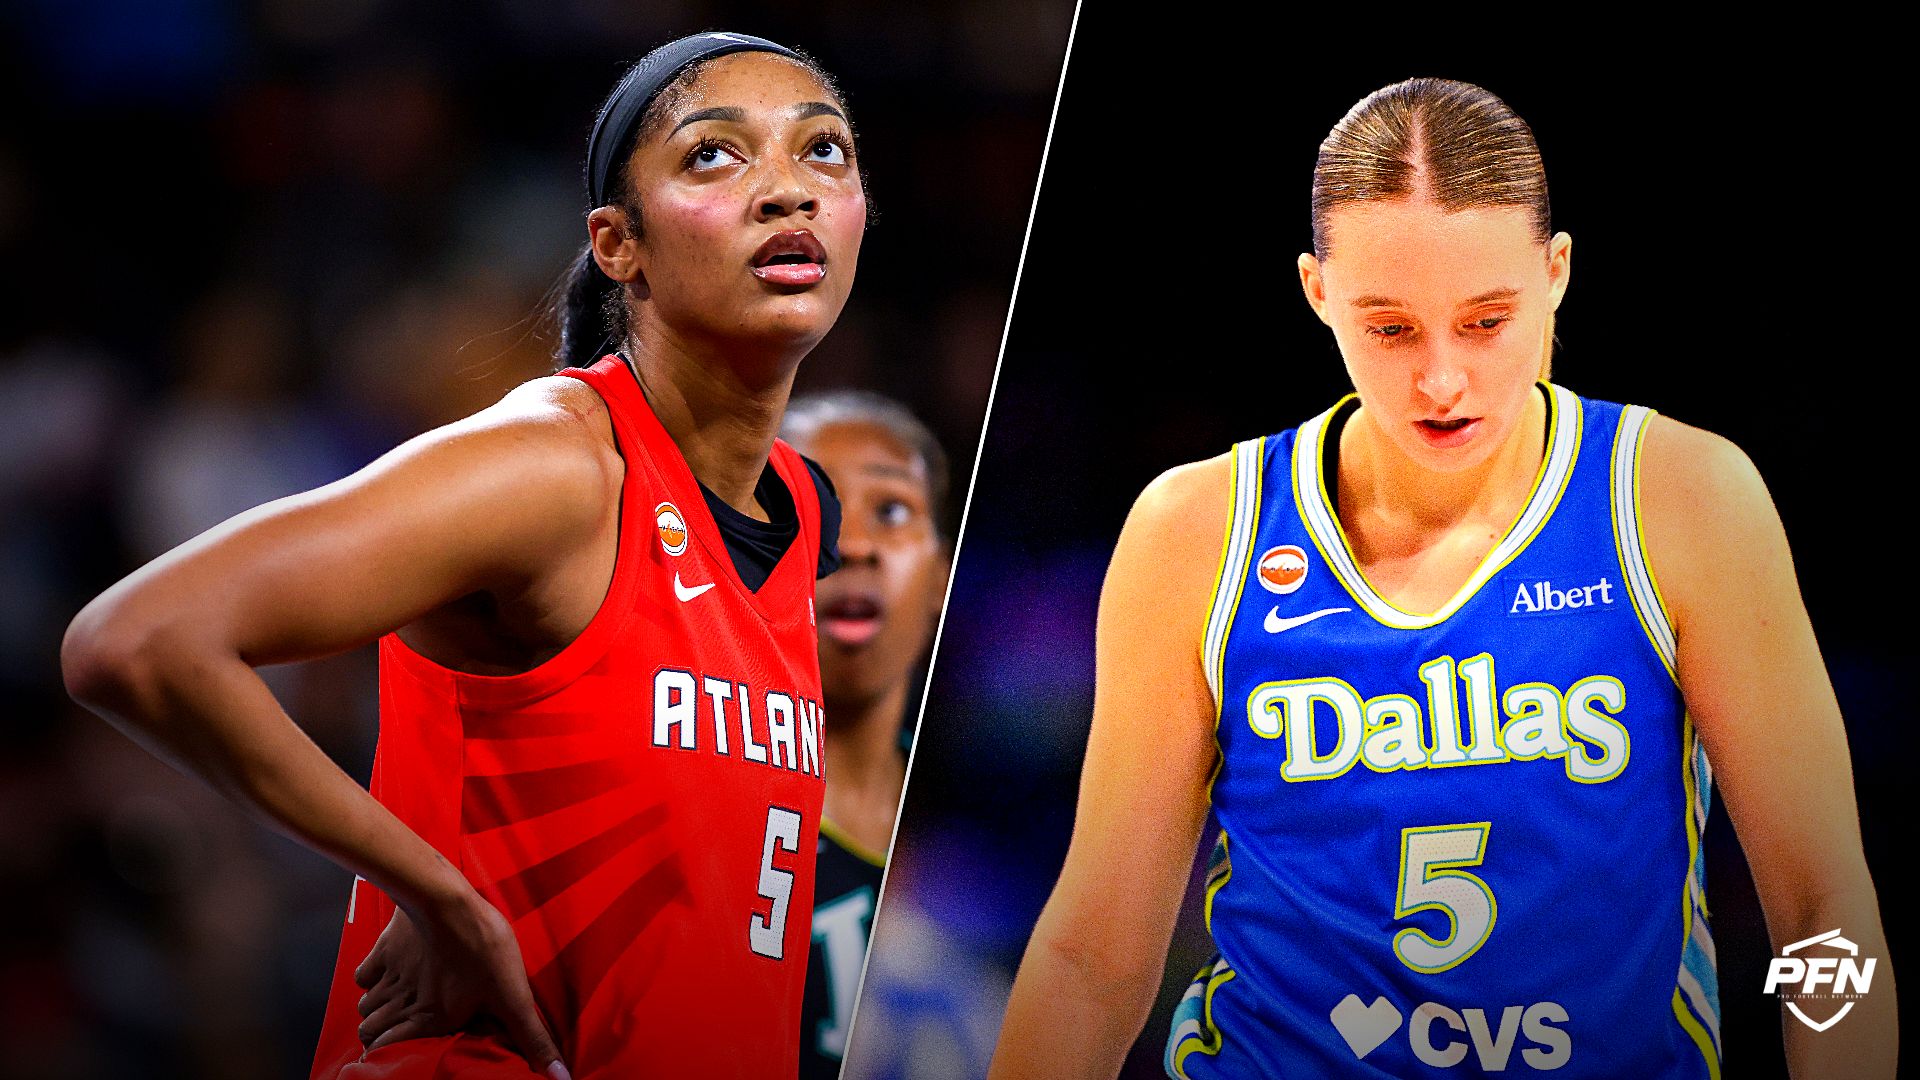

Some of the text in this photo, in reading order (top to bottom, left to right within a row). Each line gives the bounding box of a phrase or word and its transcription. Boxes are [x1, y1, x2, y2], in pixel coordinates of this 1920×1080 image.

[1510, 577, 1614, 613] Albert
[1247, 652, 1631, 784] Dallas
[749, 804, 802, 962] 5
[1393, 821, 1498, 975] 5
[1409, 1001, 1572, 1071] CVS
